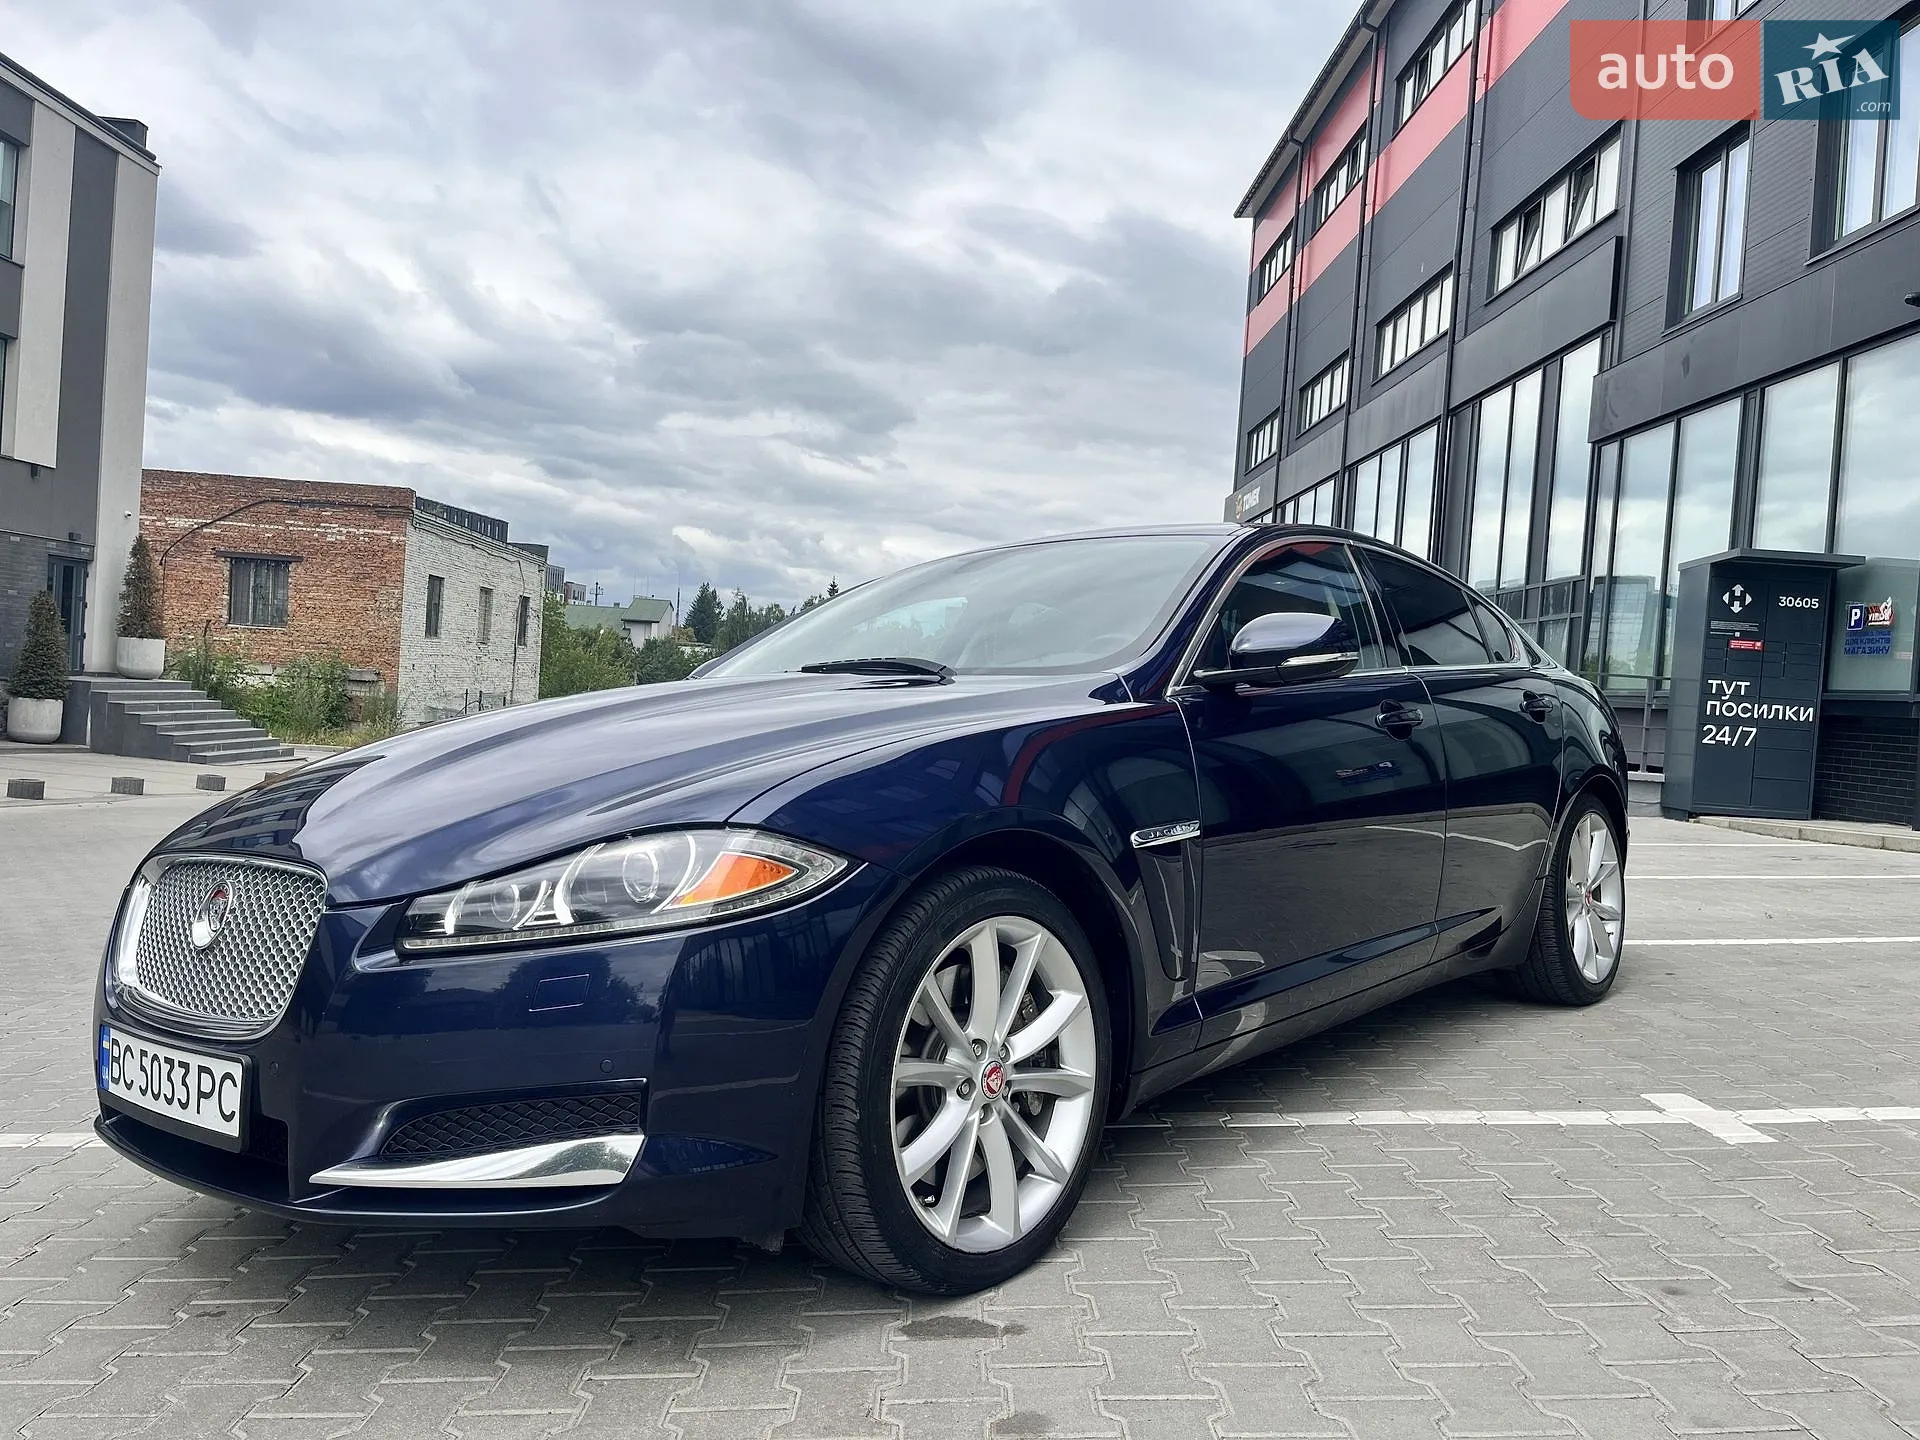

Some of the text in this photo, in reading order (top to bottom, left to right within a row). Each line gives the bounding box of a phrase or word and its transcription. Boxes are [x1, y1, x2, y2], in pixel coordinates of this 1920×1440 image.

[1778, 596, 1820, 609] 30605
[1850, 608, 1861, 627] P
[1843, 645, 1890, 656] МАГАЗИНУ
[1701, 724, 1757, 747] 24/7
[111, 1037, 238, 1122] BC 5033 PC
